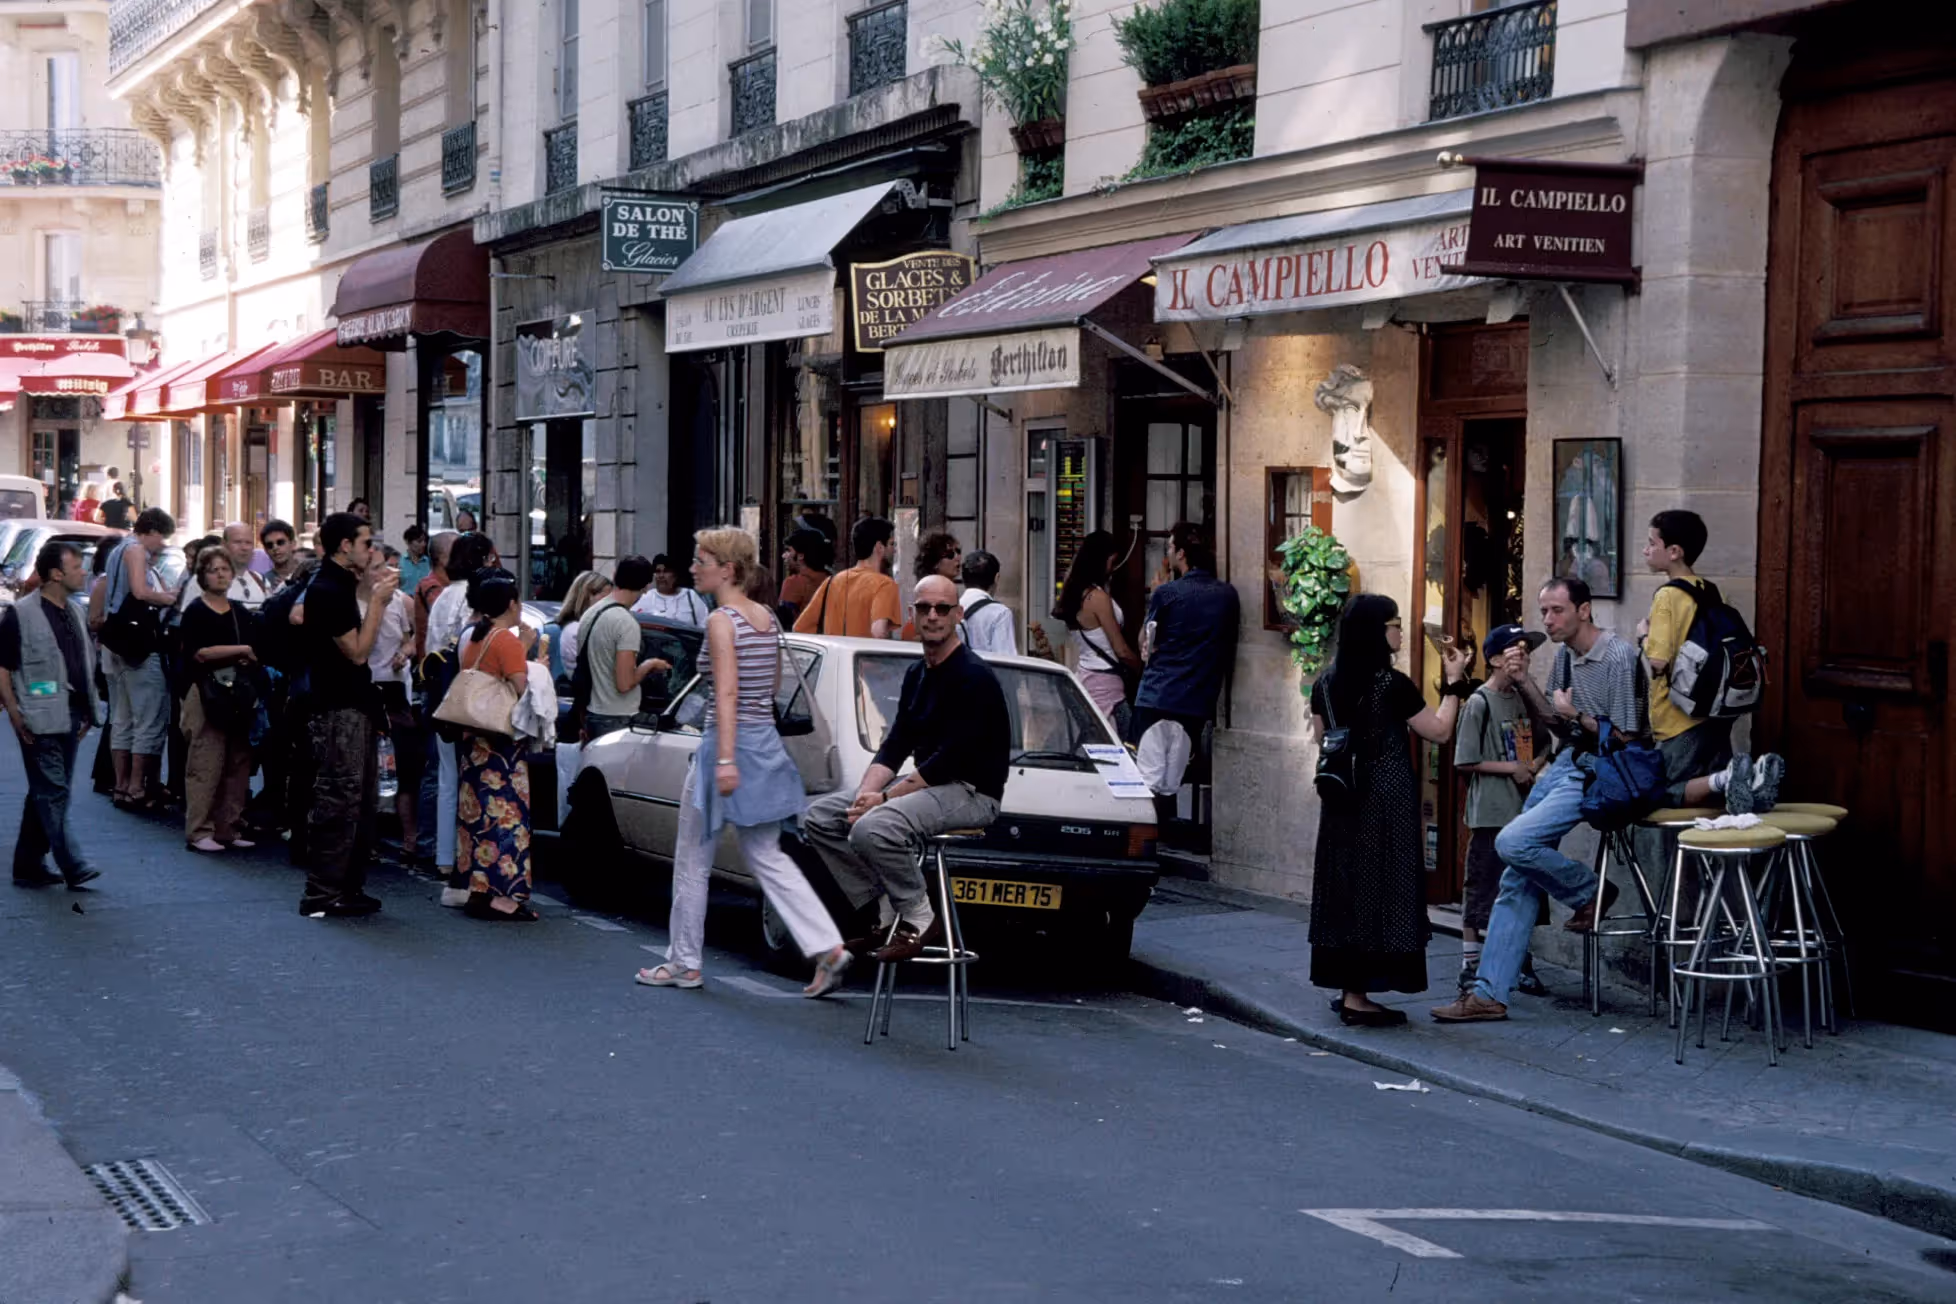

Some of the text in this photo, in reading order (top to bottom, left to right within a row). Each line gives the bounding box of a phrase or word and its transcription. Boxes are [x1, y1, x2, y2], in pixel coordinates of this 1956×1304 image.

[1481, 187, 1626, 213] IL CAMPIELLO
[617, 206, 685, 223] SALON
[612, 222, 687, 240] DE THÉ
[1435, 223, 1471, 251] ART
[622, 240, 678, 267] Glacier
[1494, 234, 1605, 253] ART VENITIEN
[904, 259, 939, 269] VENTE
[1167, 240, 1390, 310] IL CAMPIELLO
[866, 268, 964, 290] GLACES &
[738, 287, 785, 318] D'ARGENT
[860, 310, 880, 325] DE
[885, 309, 906, 323] LA
[991, 341, 1068, 386] Berthillon
[319, 368, 373, 389] BAR
[1061, 825, 1091, 835] 205
[954, 880, 1052, 907] 361 MER 75
